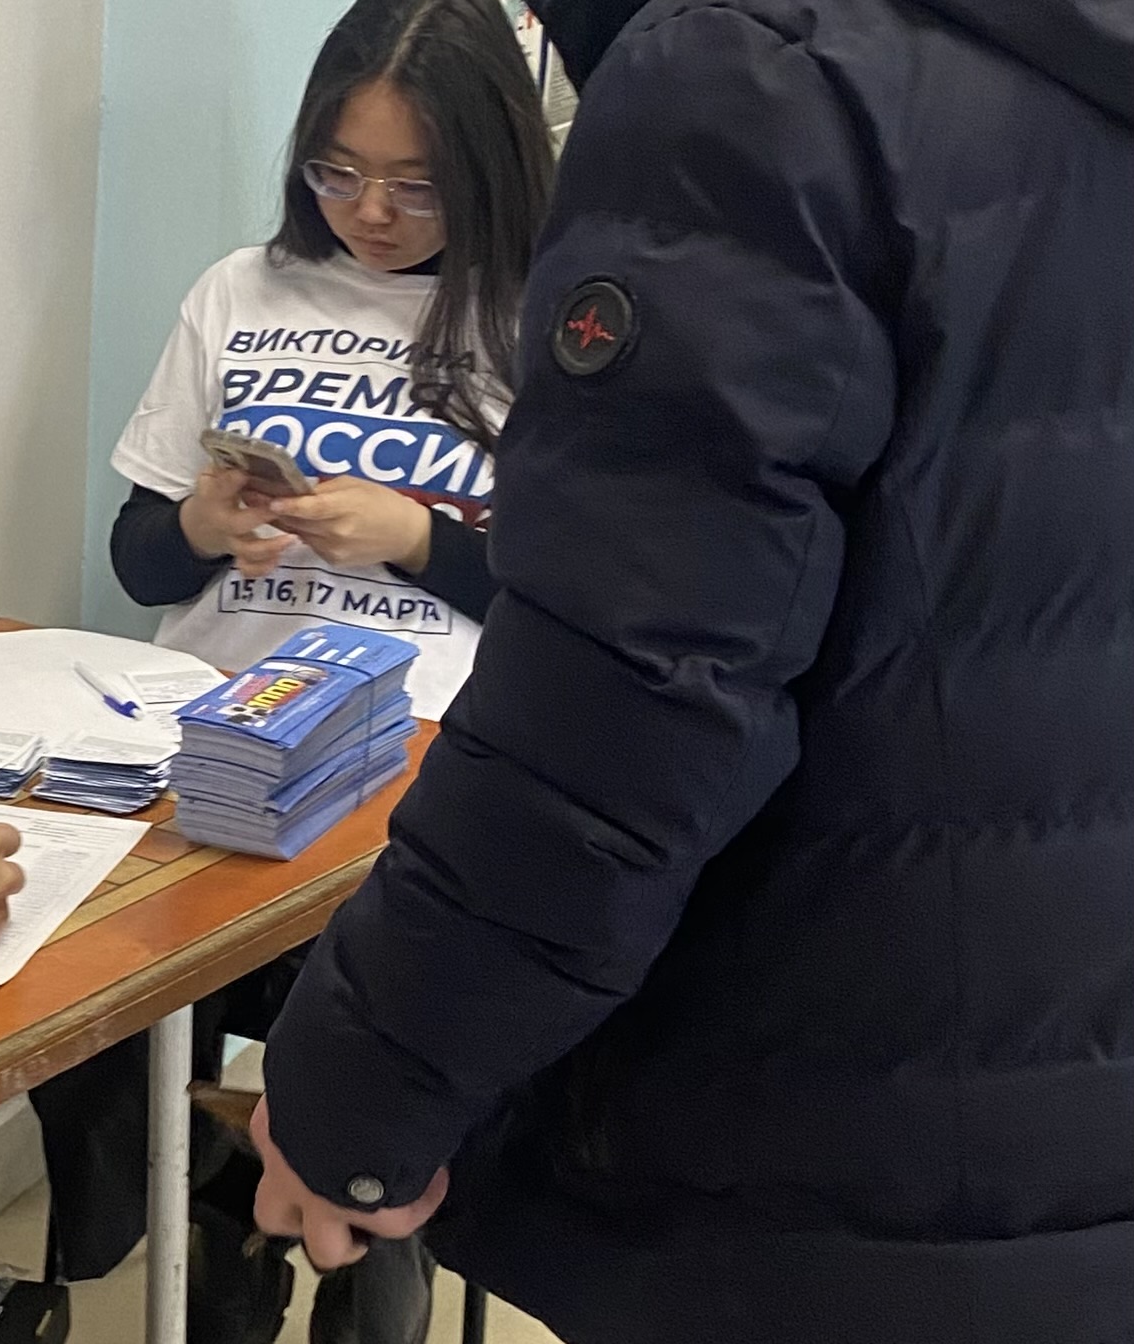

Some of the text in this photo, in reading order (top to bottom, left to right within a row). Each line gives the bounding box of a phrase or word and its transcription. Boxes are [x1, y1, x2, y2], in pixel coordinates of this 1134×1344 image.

[264, 578, 297, 606] 16,
[306, 580, 335, 605] 17
[341, 589, 441, 621] МАРТА
